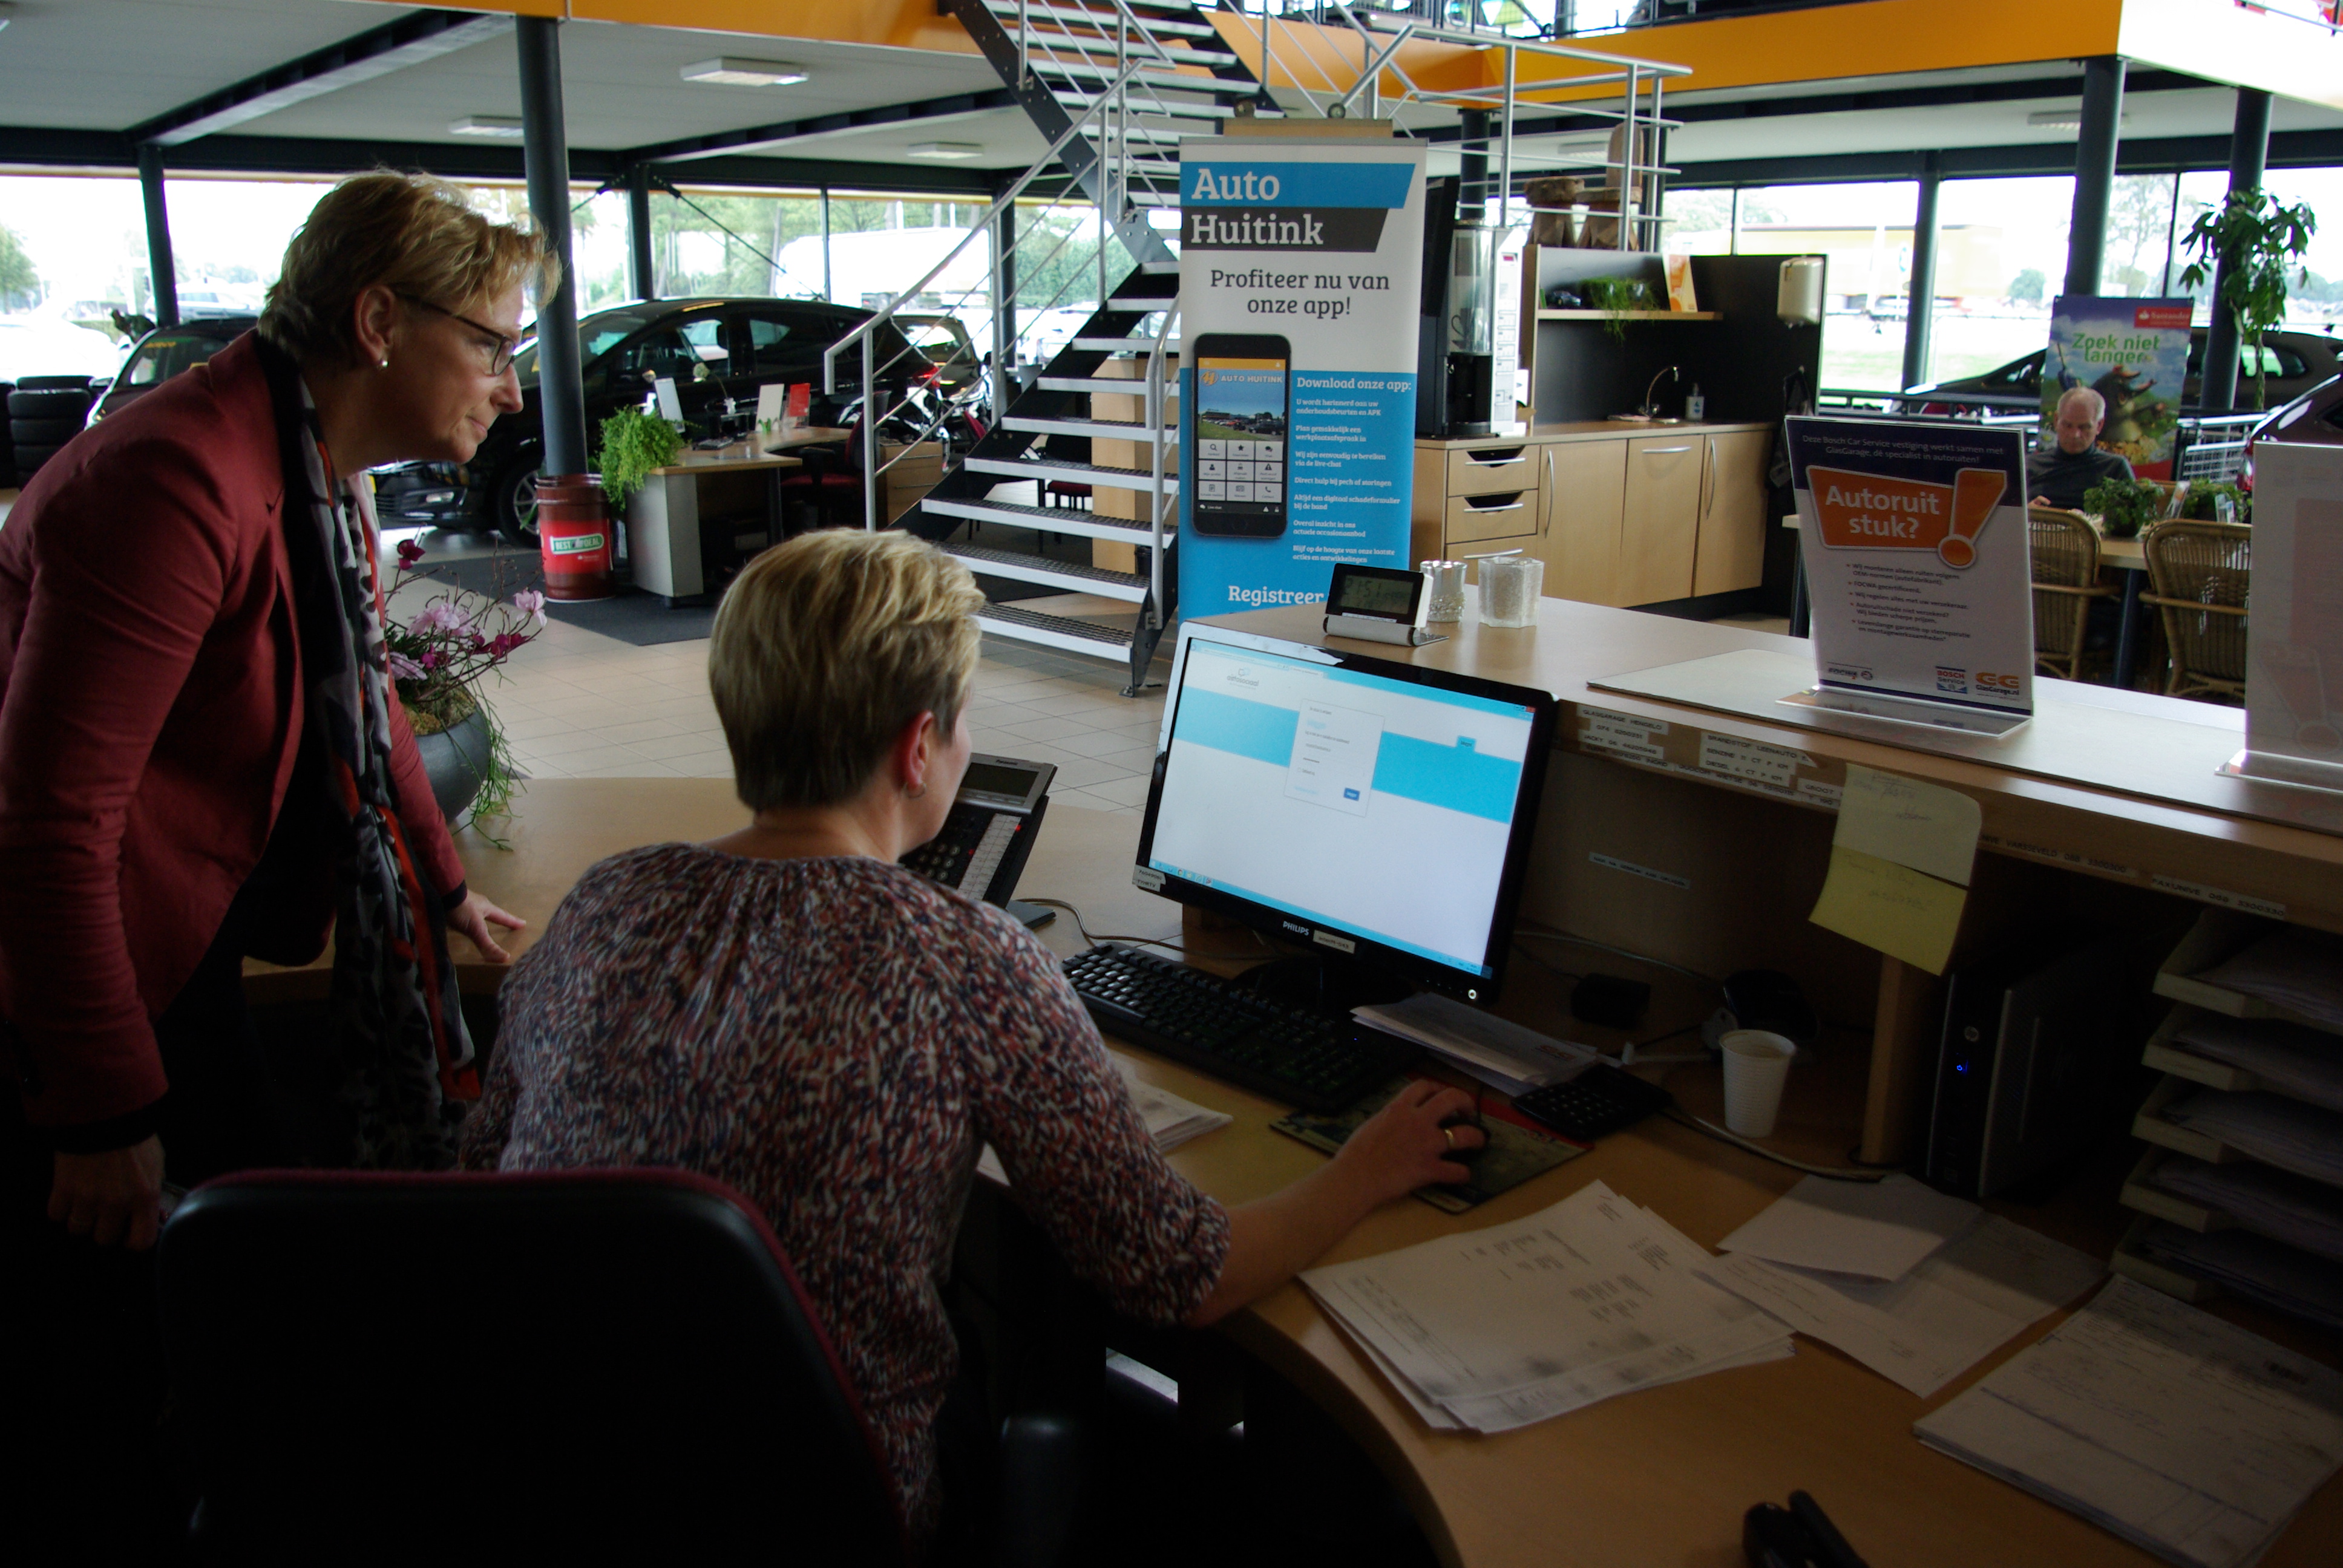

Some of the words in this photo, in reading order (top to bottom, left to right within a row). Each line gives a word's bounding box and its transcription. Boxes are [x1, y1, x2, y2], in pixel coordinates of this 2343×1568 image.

[1191, 168, 1280, 201] Auto
[1191, 214, 1324, 246] Huitink
[1210, 269, 1308, 289] Profiteer
[1314, 274, 1342, 289] nu
[1348, 275, 1390, 290] van
[1247, 299, 1298, 314] onze
[1303, 296, 1351, 319] app!
[2124, 335, 2160, 350] niet
[1297, 377, 1355, 390] Download
[1357, 381, 1384, 390] onze
[1386, 381, 1412, 393] app:
[1802, 435, 1822, 443] Deze
[1823, 436, 1846, 445] Bosch
[1862, 439, 1890, 448] Service
[1892, 442, 1929, 452] vestiging
[1986, 446, 2004, 455] met
[1885, 450, 1922, 460] specialist
[1933, 453, 1980, 463] autoruiten!
[1314, 477, 1328, 486] hulp
[1825, 485, 1940, 516] Autoruit
[1849, 514, 1919, 539] stuk?
[555, 541, 571, 549] BEST
[584, 538, 599, 547] DEAL
[1228, 585, 1325, 607] Registreer
[1937, 670, 1965, 679] BOSCH
[1938, 676, 1965, 685] Service
[1976, 684, 2019, 696] GlasGarage.nl
[1583, 710, 1625, 722] GLASGARAGE
[1630, 719, 1662, 730] HENGELO
[1707, 748, 1735, 758] BENZINE
[1708, 734, 1752, 749] BRANDSTOF
[1757, 745, 1797, 759] LEENAUTO
[1705, 760, 1729, 770] DIESEL
[2006, 839, 2057, 857] VARSSEVELD
[2064, 853, 2080, 863] 088
[2172, 883, 2201, 895] UNIVE
[2209, 893, 2229, 903] 088
[1283, 920, 1309, 936] PHILIPS
